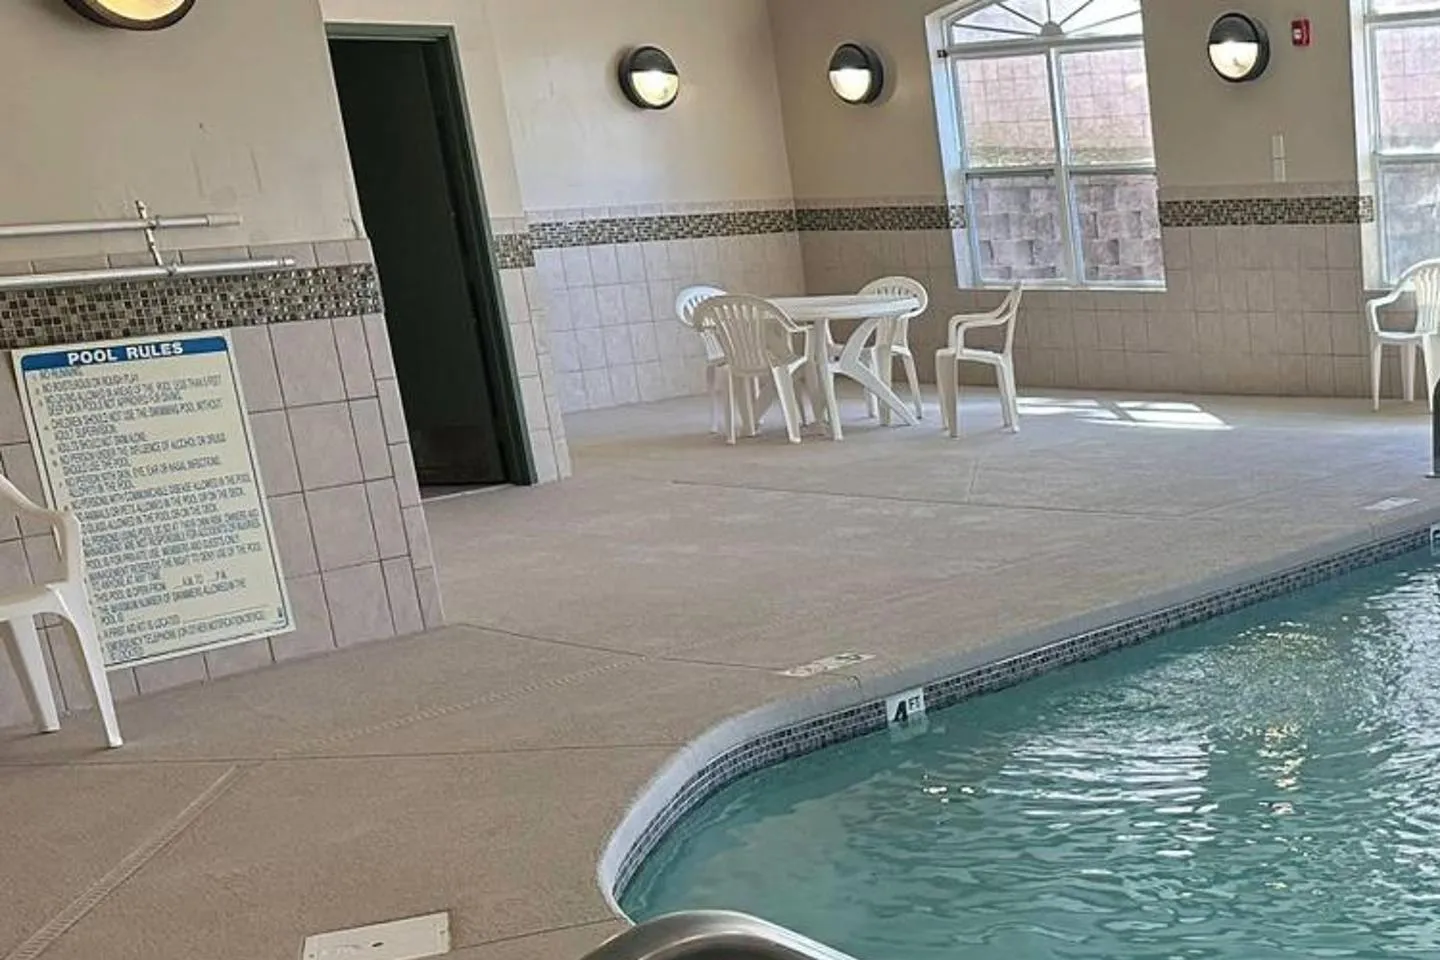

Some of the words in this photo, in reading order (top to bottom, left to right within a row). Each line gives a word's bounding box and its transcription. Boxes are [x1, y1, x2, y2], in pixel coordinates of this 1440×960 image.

[67, 349, 118, 366] POOL
[126, 342, 183, 360] RULES
[908, 696, 921, 711] FT
